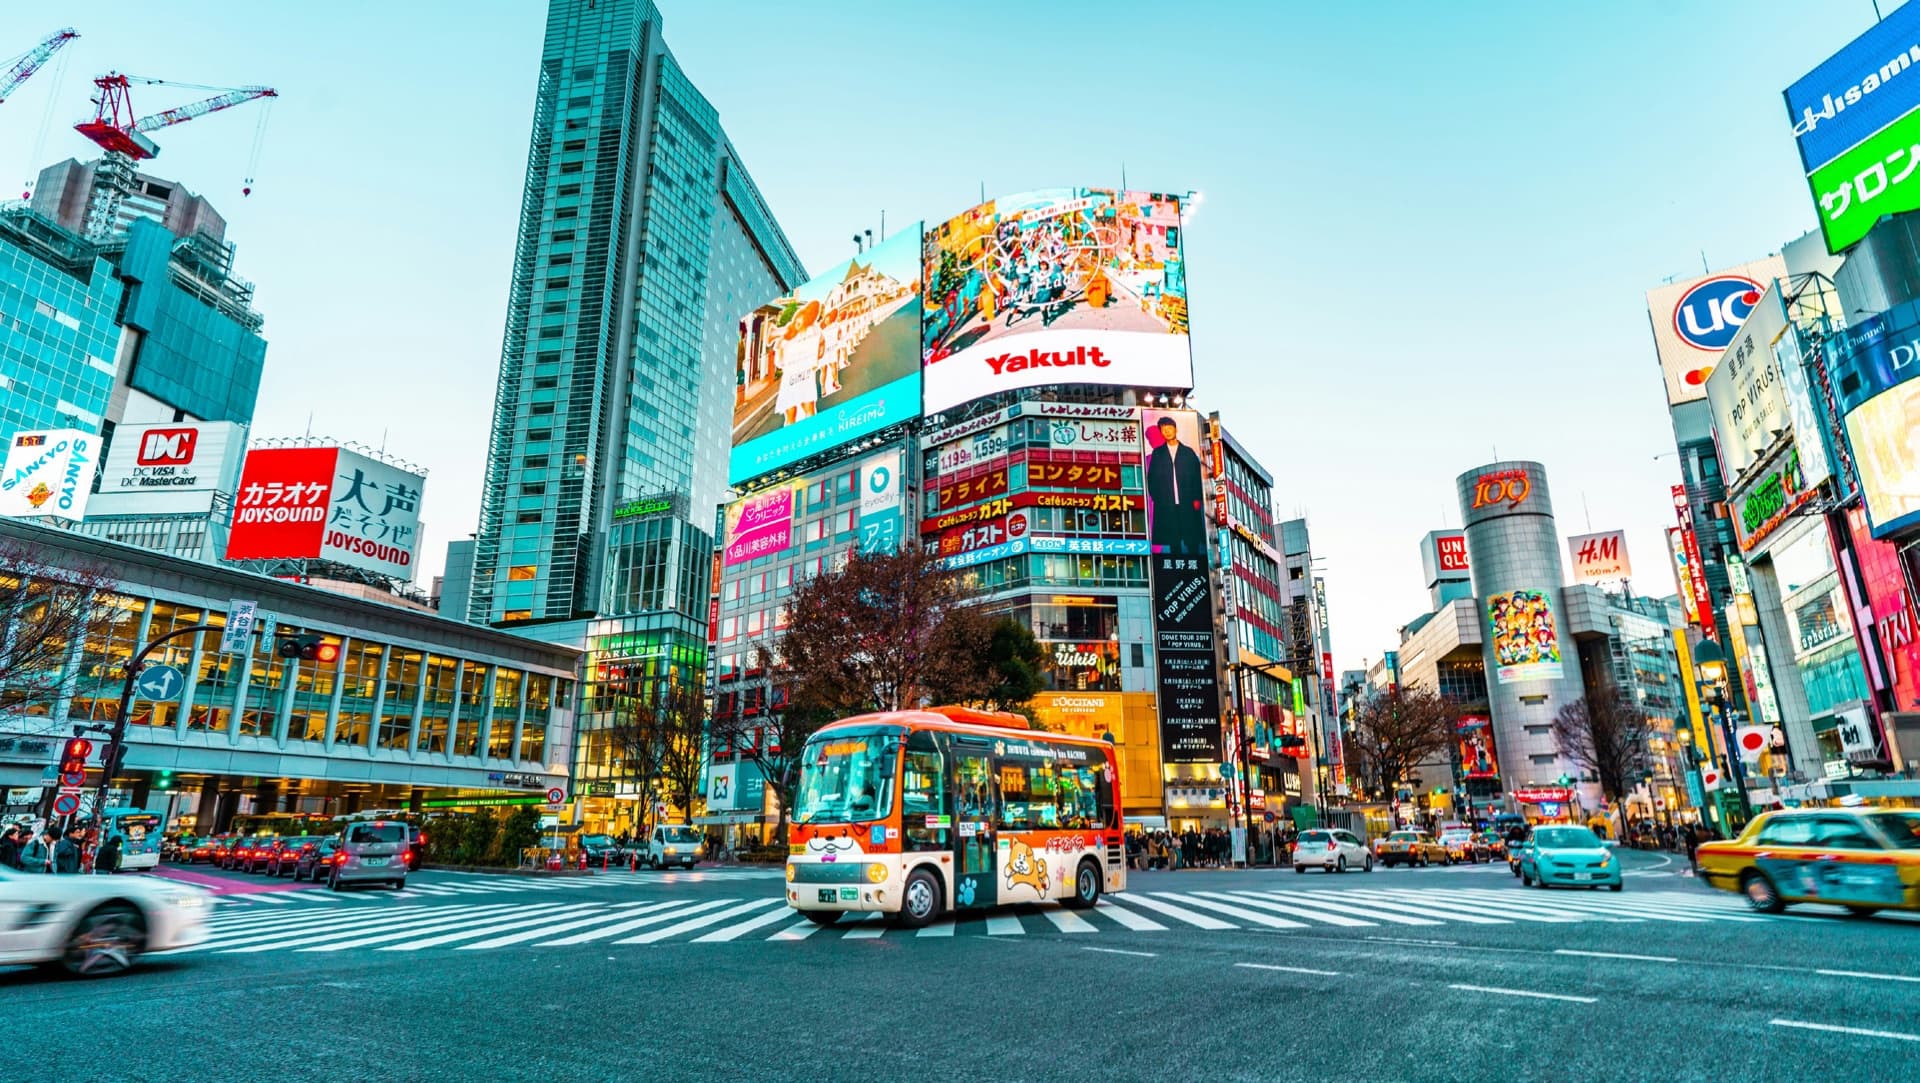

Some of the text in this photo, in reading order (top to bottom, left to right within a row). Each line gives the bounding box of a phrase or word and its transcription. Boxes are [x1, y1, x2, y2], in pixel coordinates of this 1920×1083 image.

[1847, 322, 1885, 349] Channel
[985, 346, 1111, 375] Yakult
[1747, 364, 1774, 405] VIRUS
[837, 403, 886, 432] KIREIMO
[1040, 404, 1135, 417] しゃぶしゃぶバイキング
[1081, 425, 1137, 443] しゃぶ葉
[143, 433, 191, 460] DC
[2, 440, 68, 491] SANKYO
[58, 438, 89, 510] SANKYO
[133, 467, 149, 477] DC
[152, 466, 175, 476] VISA
[925, 456, 938, 470] 9F
[1028, 464, 1118, 484] コンタクト
[120, 476, 197, 487] DC MasterCard
[333, 468, 419, 516] 大声
[241, 481, 328, 506] カラオケ
[1093, 494, 1135, 511] ガスト
[1471, 478, 1531, 510] 109
[237, 506, 325, 523] JOYSOUND
[979, 498, 1014, 520] ガスト
[325, 530, 410, 566] JOYSOUND
[735, 530, 787, 558] 品川美容外科
[924, 541, 939, 556] 7F
[961, 525, 1003, 552] ガスト
[1068, 540, 1148, 552] 英会話イーオン
[1577, 535, 1619, 565] H&M
[1052, 696, 1105, 707] L'OCCITANE
[1283, 771, 1301, 790] LUSH
[1045, 834, 1086, 854] ハチ公バス
